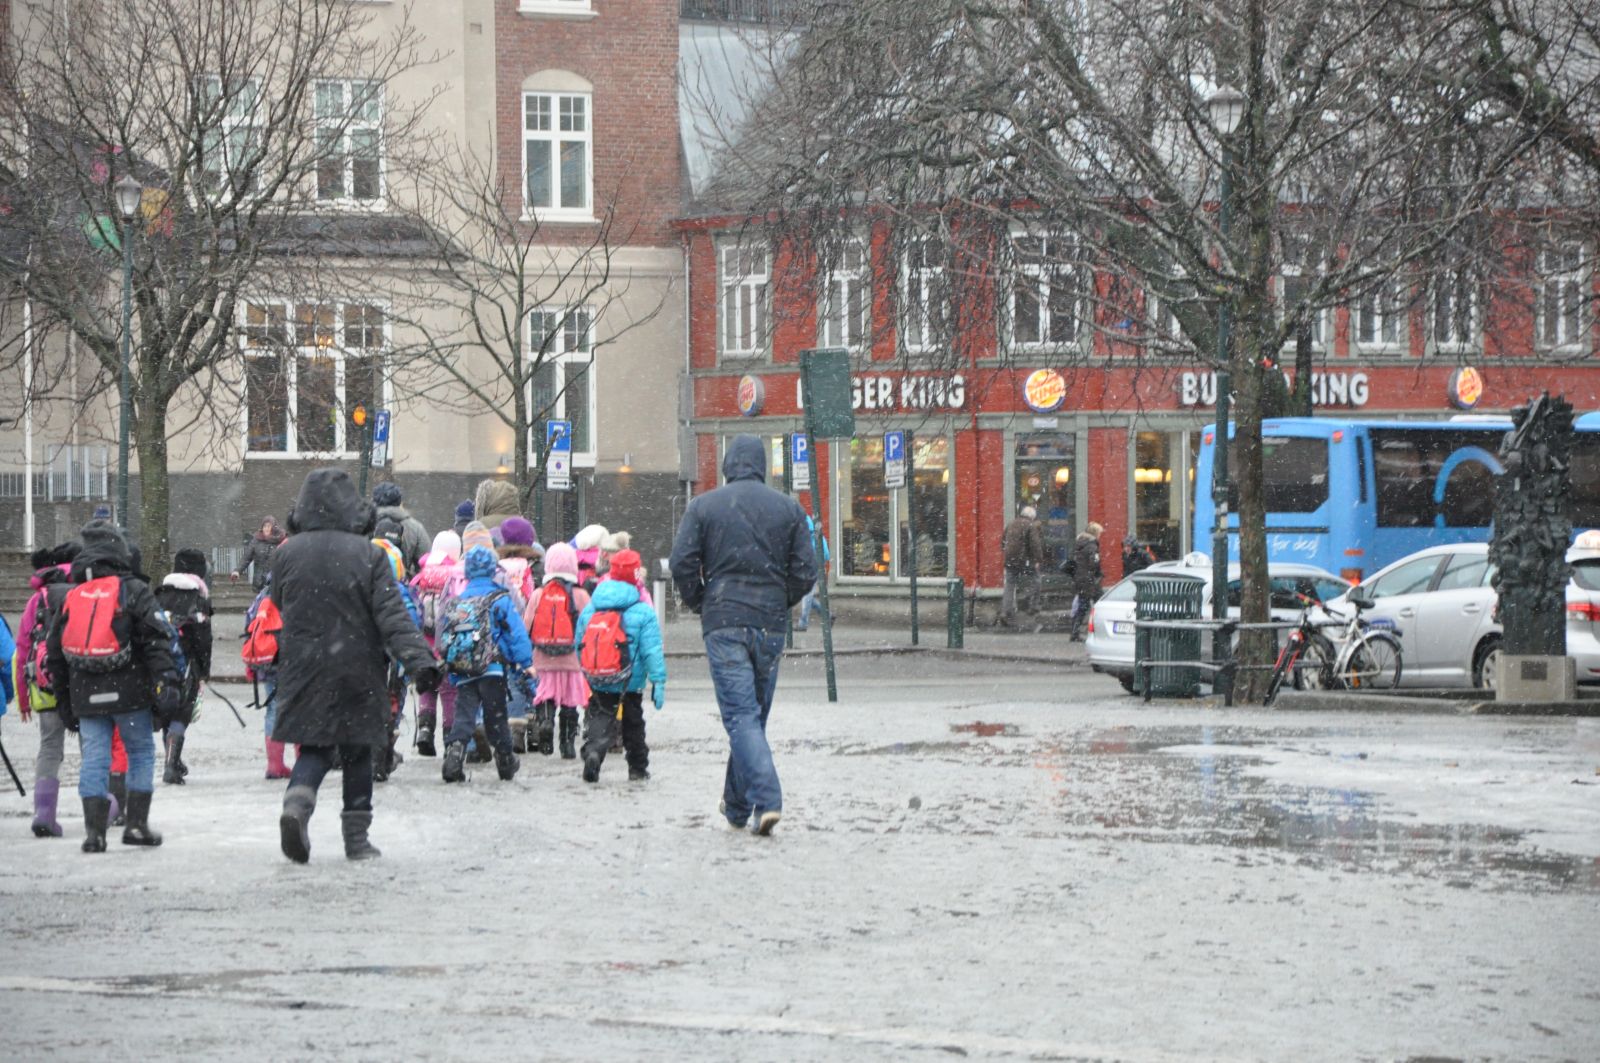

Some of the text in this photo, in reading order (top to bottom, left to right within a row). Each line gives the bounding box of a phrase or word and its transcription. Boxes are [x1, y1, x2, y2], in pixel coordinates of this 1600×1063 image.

[901, 374, 965, 408] KING
[1029, 382, 1063, 403] KING
[377, 414, 385, 439] P
[796, 437, 807, 460] P
[889, 435, 900, 458] P
